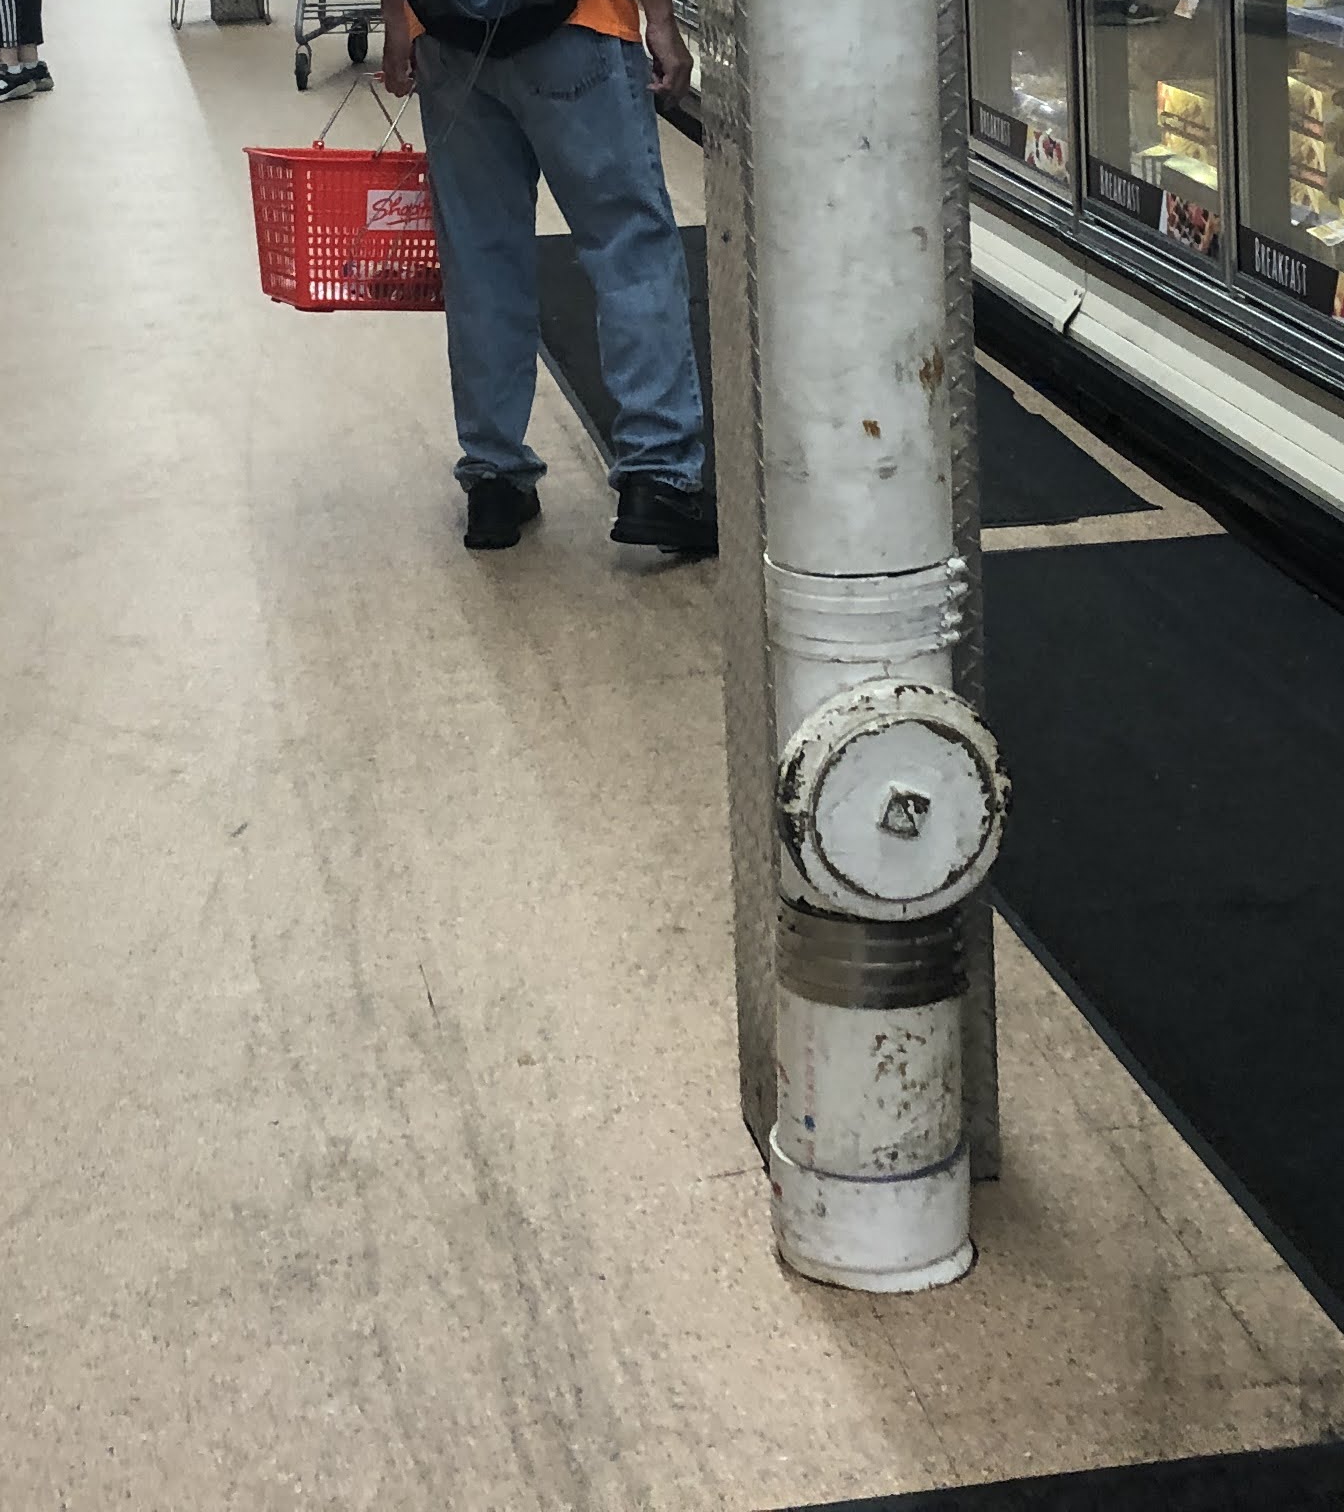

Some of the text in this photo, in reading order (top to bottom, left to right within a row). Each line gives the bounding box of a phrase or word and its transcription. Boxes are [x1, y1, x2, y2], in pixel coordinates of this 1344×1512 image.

[980, 105, 1011, 149] BREAKFAST
[1099, 165, 1140, 214] BREAKFAST
[1254, 237, 1307, 297] BREAKFAST
